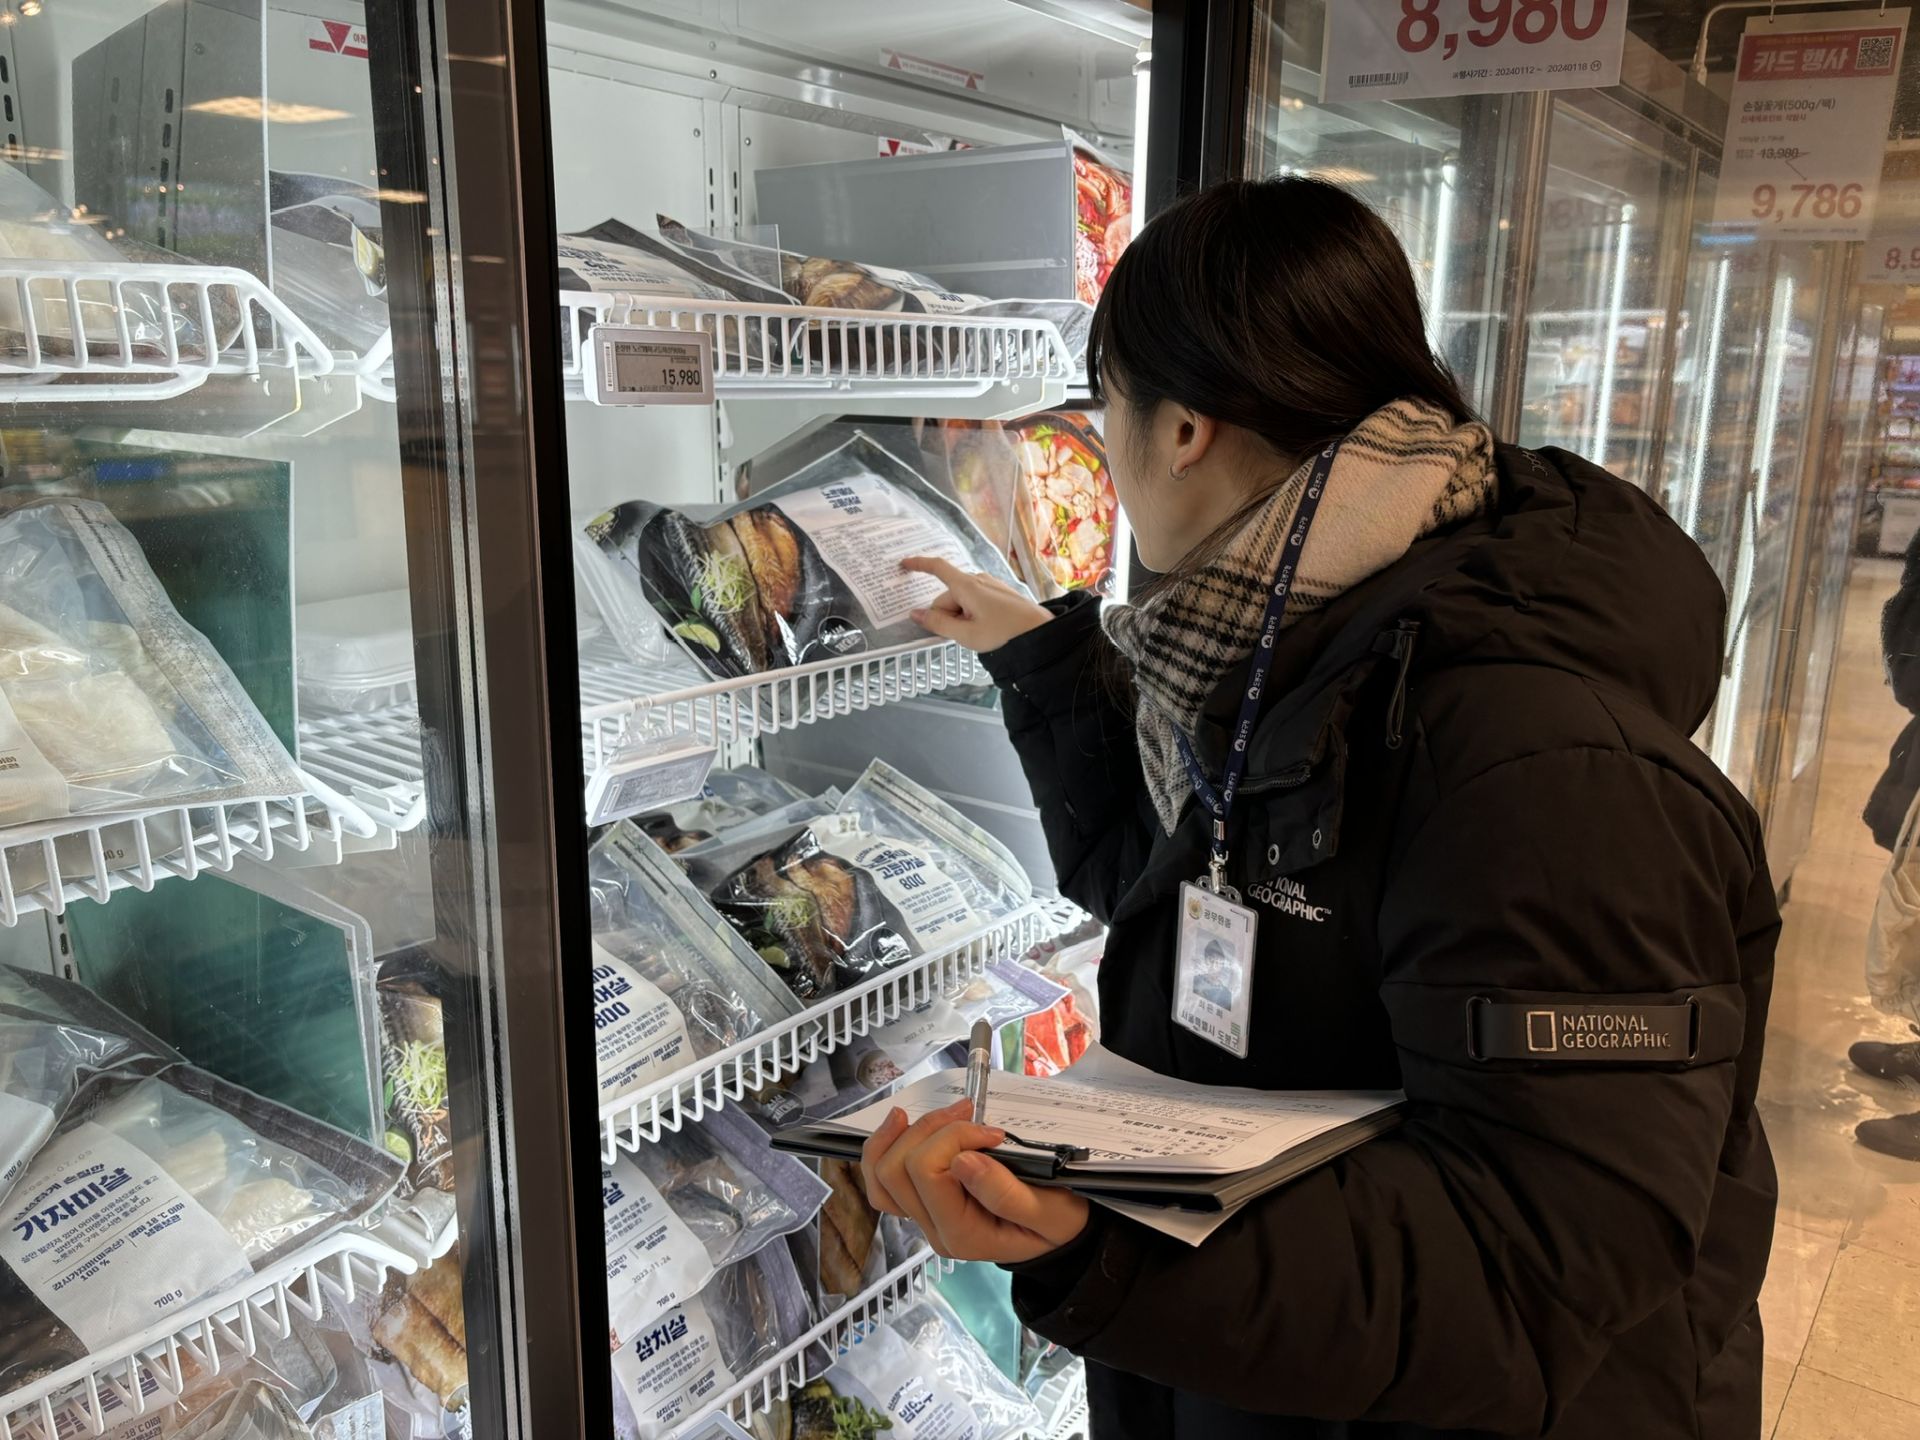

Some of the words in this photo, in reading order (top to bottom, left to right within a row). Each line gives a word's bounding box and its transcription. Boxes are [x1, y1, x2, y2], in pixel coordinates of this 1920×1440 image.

[1753, 49, 1798, 73] 카드
[1801, 47, 1850, 72] 행사
[1752, 182, 1864, 223] 9,786
[875, 857, 927, 880] 고등어살
[899, 873, 926, 891] 800
[1266, 876, 1307, 901] IONAL
[594, 1001, 631, 1030] 800
[1562, 1014, 1649, 1032] NATIONAL
[1562, 1032, 1671, 1048] GEOGRAPHIC
[3, 1165, 17, 1182] 700
[12, 1167, 133, 1242] 가자미살
[167, 1202, 186, 1215] 이하
[80, 1265, 100, 1282] 100
[99, 1258, 111, 1267] %
[154, 1291, 175, 1309] 700
[174, 1288, 184, 1299] g
[635, 1314, 689, 1363] 삼치살
